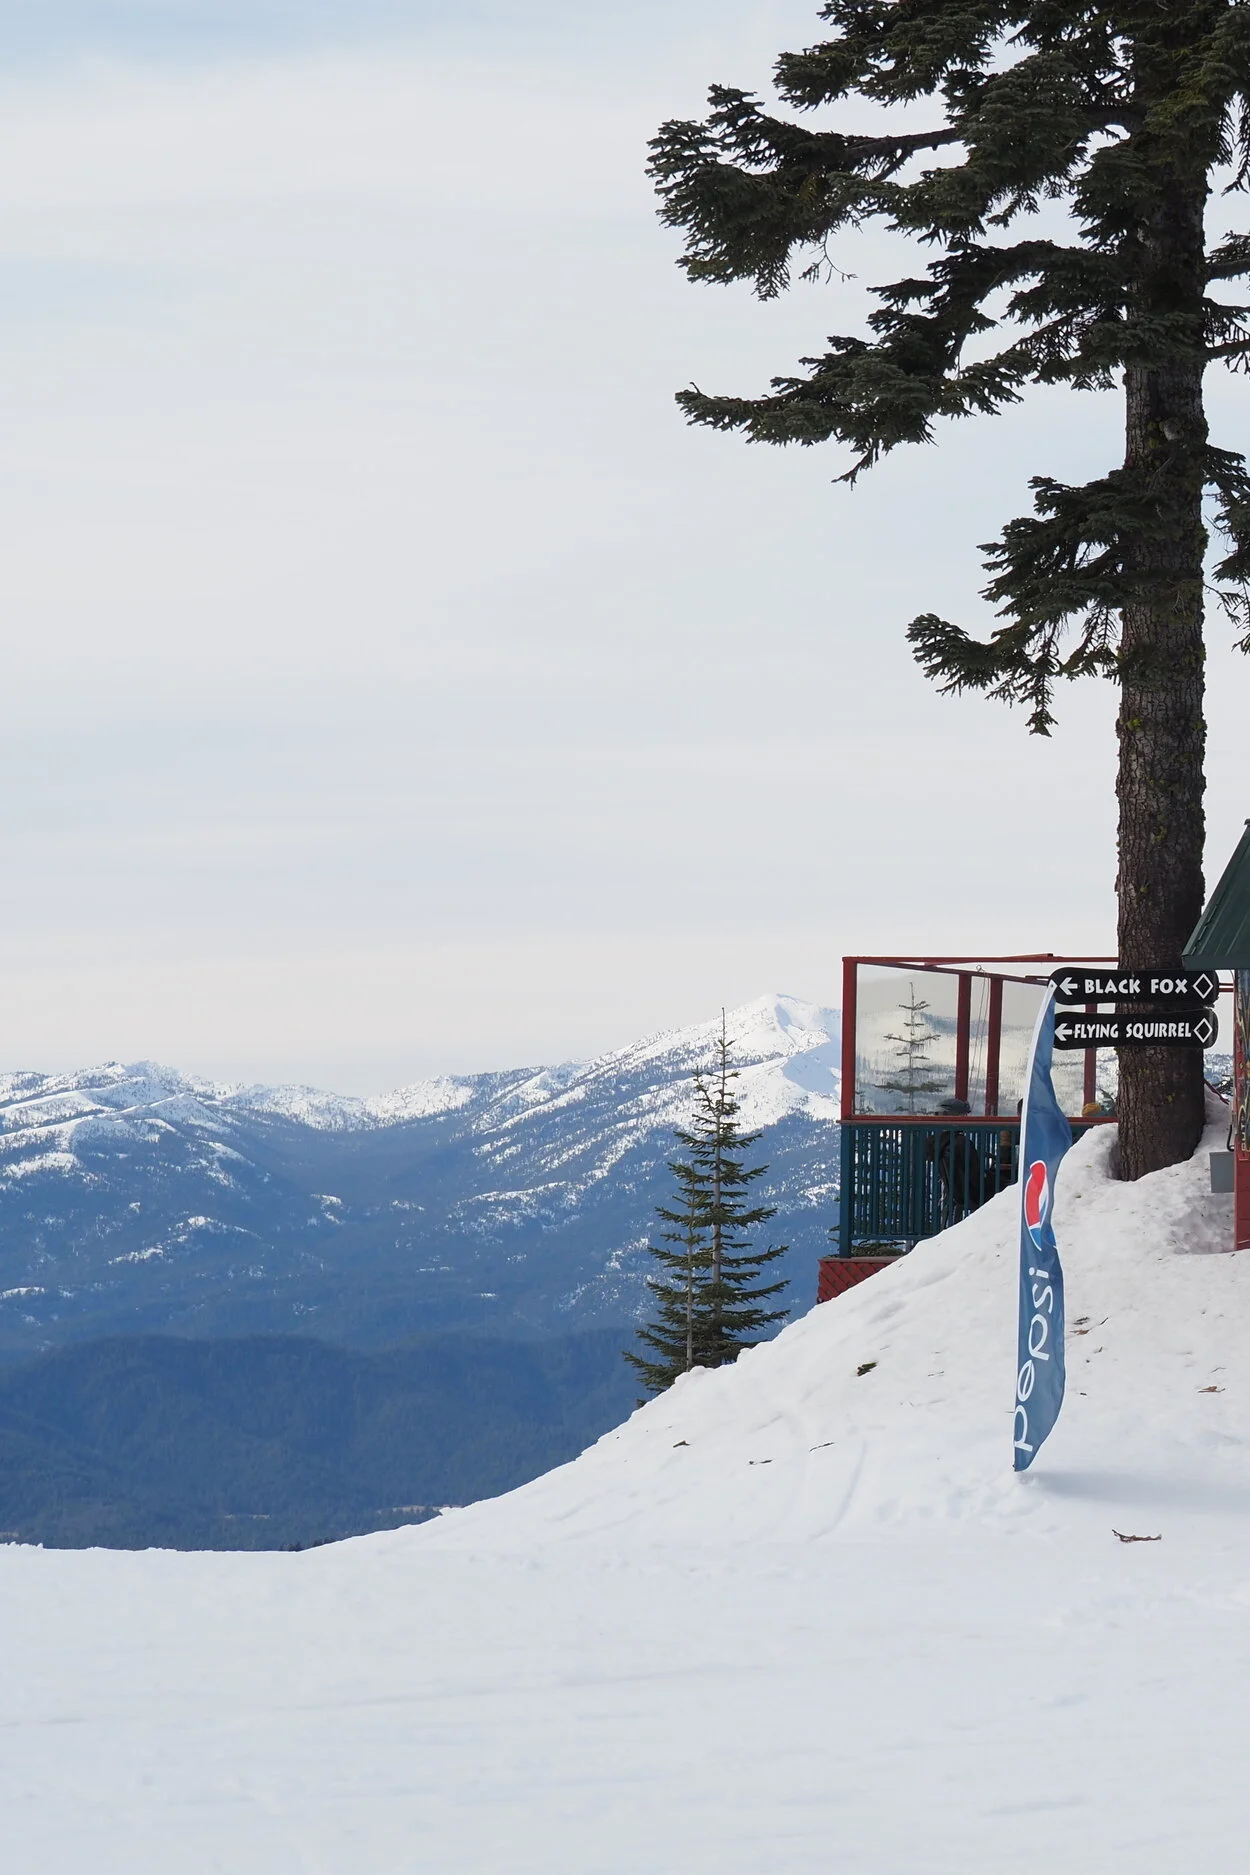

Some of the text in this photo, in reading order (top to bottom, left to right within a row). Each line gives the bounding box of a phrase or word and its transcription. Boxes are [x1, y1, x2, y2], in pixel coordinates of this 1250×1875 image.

[1084, 978, 1188, 994] BLACK FOX
[1074, 1022, 1191, 1040] FLYING SQUIRREL
[1013, 1266, 1054, 1452] pepsi
